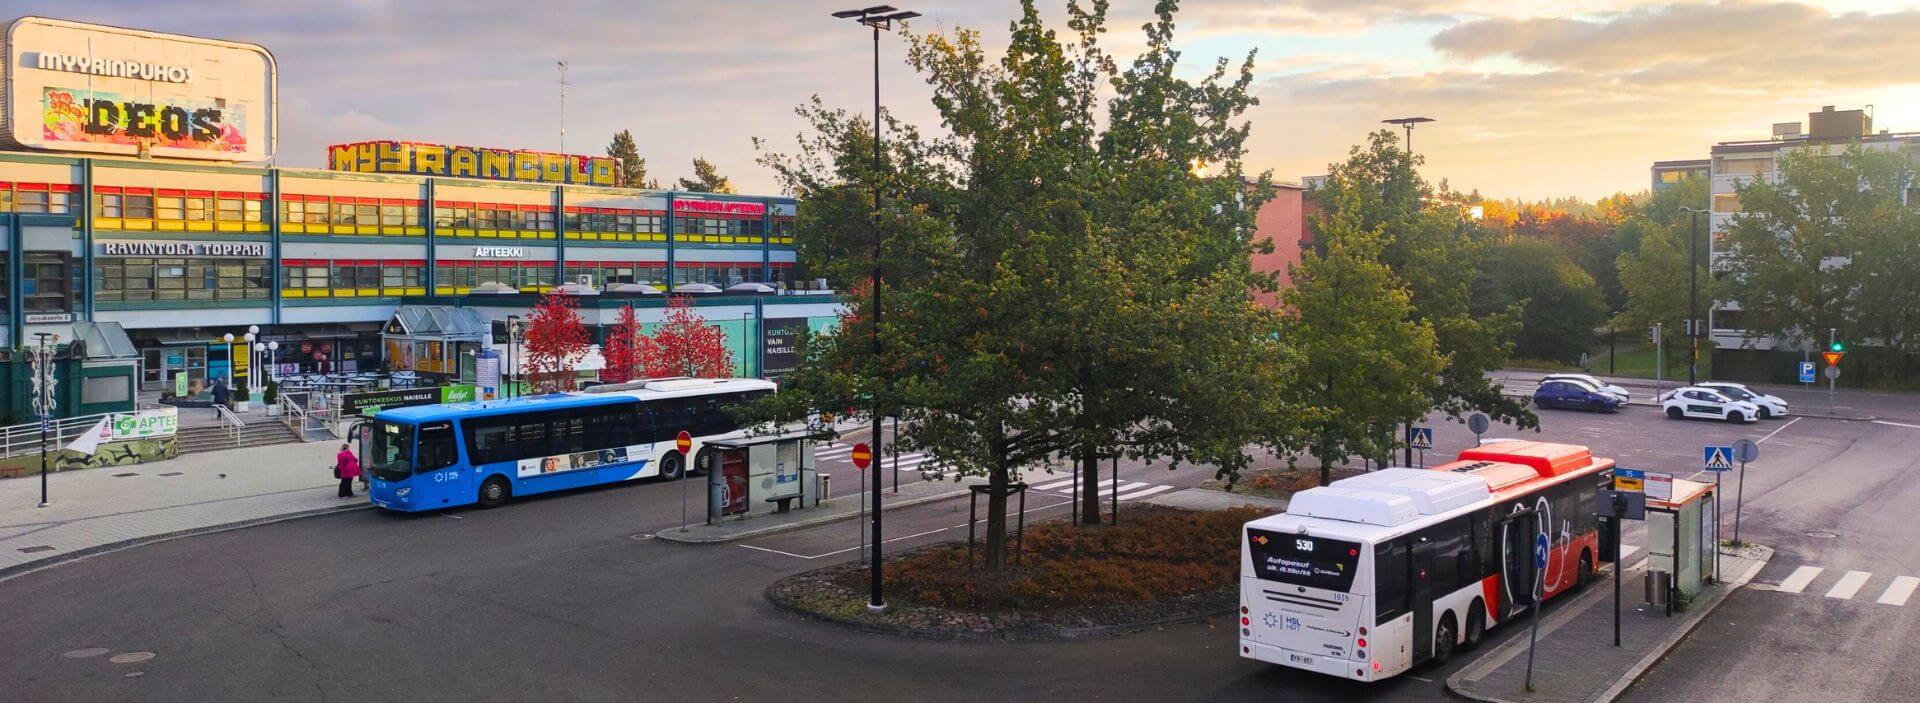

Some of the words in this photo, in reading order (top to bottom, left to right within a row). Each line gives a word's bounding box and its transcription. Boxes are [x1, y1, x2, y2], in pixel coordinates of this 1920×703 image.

[82, 97, 224, 142] DEOS
[105, 243, 196, 255] RAVINTOLA
[203, 244, 266, 256] TOPPARI
[476, 248, 523, 257] APTEEKKI
[767, 346, 796, 354] NAISILLE
[1803, 363, 1813, 375] P
[354, 396, 402, 405] KUNTOKESKUS
[403, 393, 432, 401] NAISILLE
[1296, 539, 1314, 551] 530
[1267, 556, 1310, 569] Autopesut
[1286, 616, 1301, 626] HSL
